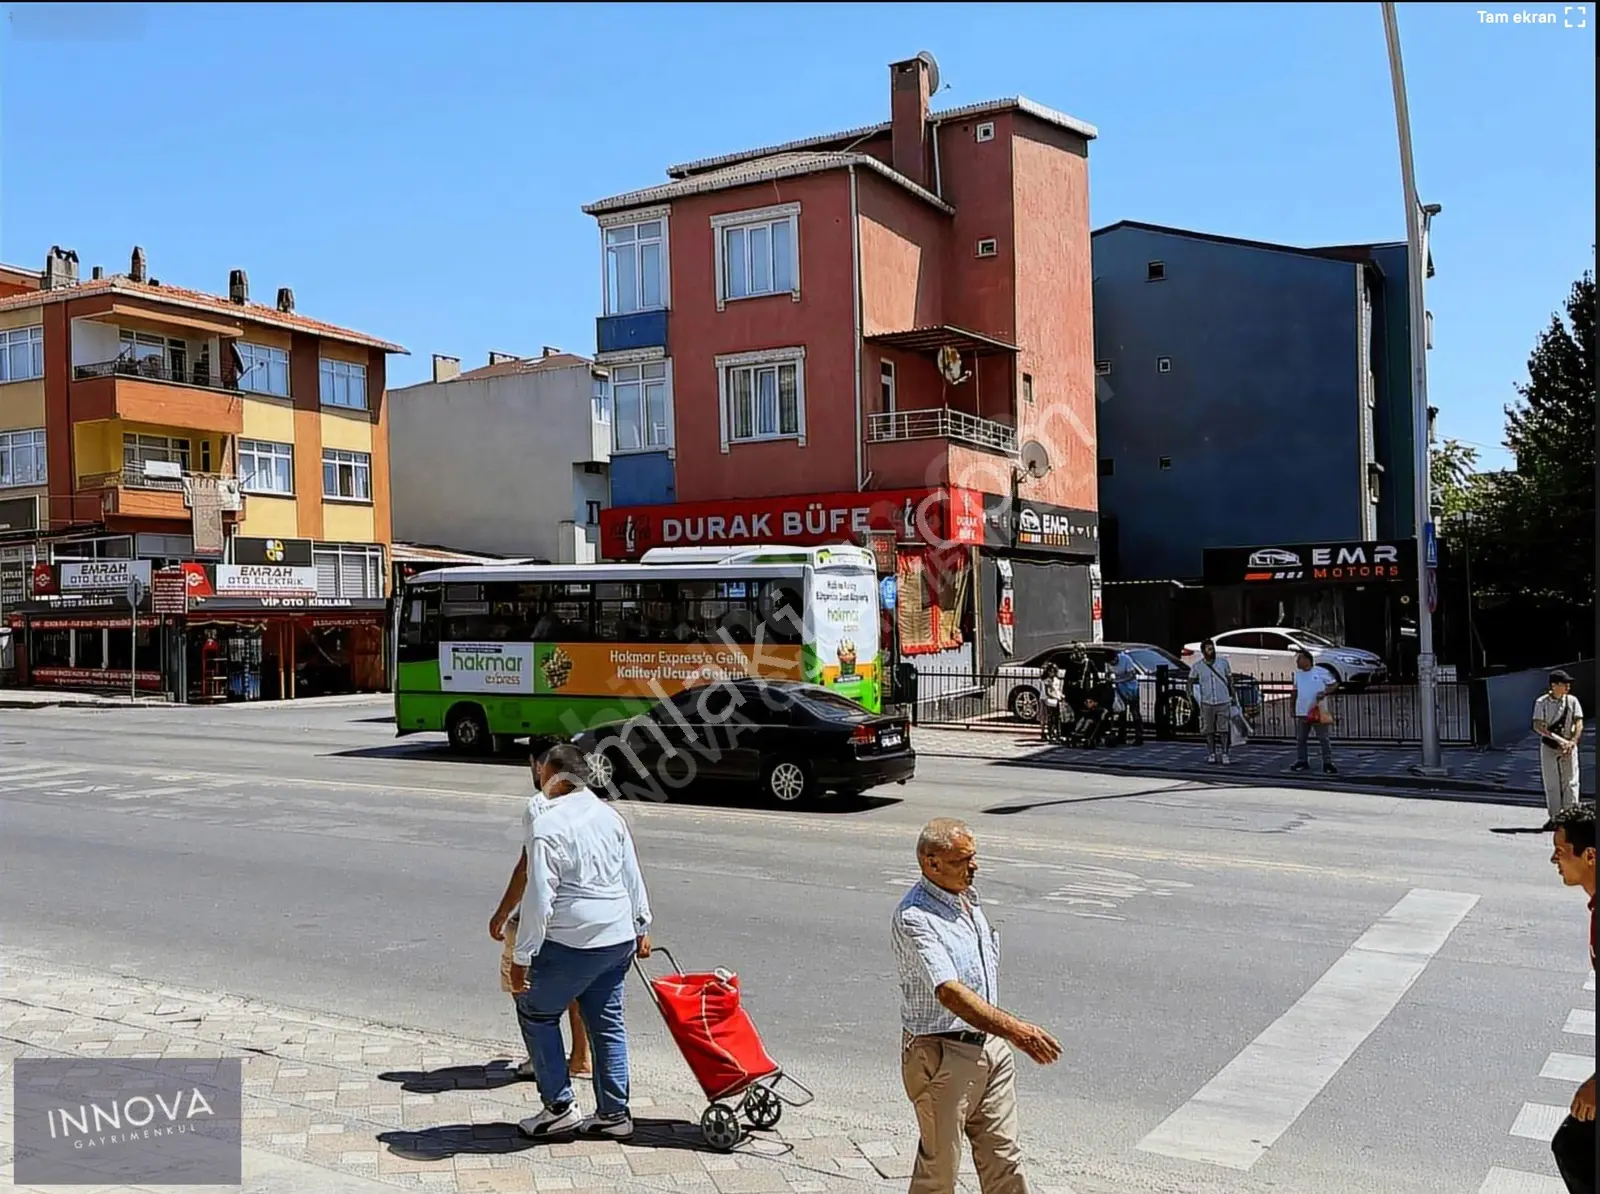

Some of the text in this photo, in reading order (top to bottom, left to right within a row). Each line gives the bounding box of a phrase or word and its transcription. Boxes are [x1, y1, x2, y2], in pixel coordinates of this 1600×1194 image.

[662, 513, 773, 542] DURAK
[783, 503, 871, 536] BÜFE
[1042, 514, 1070, 534] EMR
[1312, 545, 1398, 565] EMR
[81, 563, 127, 574] EMRAH
[240, 566, 293, 577] EMRAH
[1314, 566, 1398, 578] MOTORS
[70, 573, 140, 584] OTO ELEKTR
[228, 576, 250, 584] OTO
[261, 596, 280, 607] VİP
[282, 598, 304, 607] OTO
[452, 653, 523, 672] hakmar
[610, 650, 749, 667] Hakmar Express'e Gelin
[617, 665, 662, 680] Kaliteyi
[663, 667, 700, 680] Ucuza
